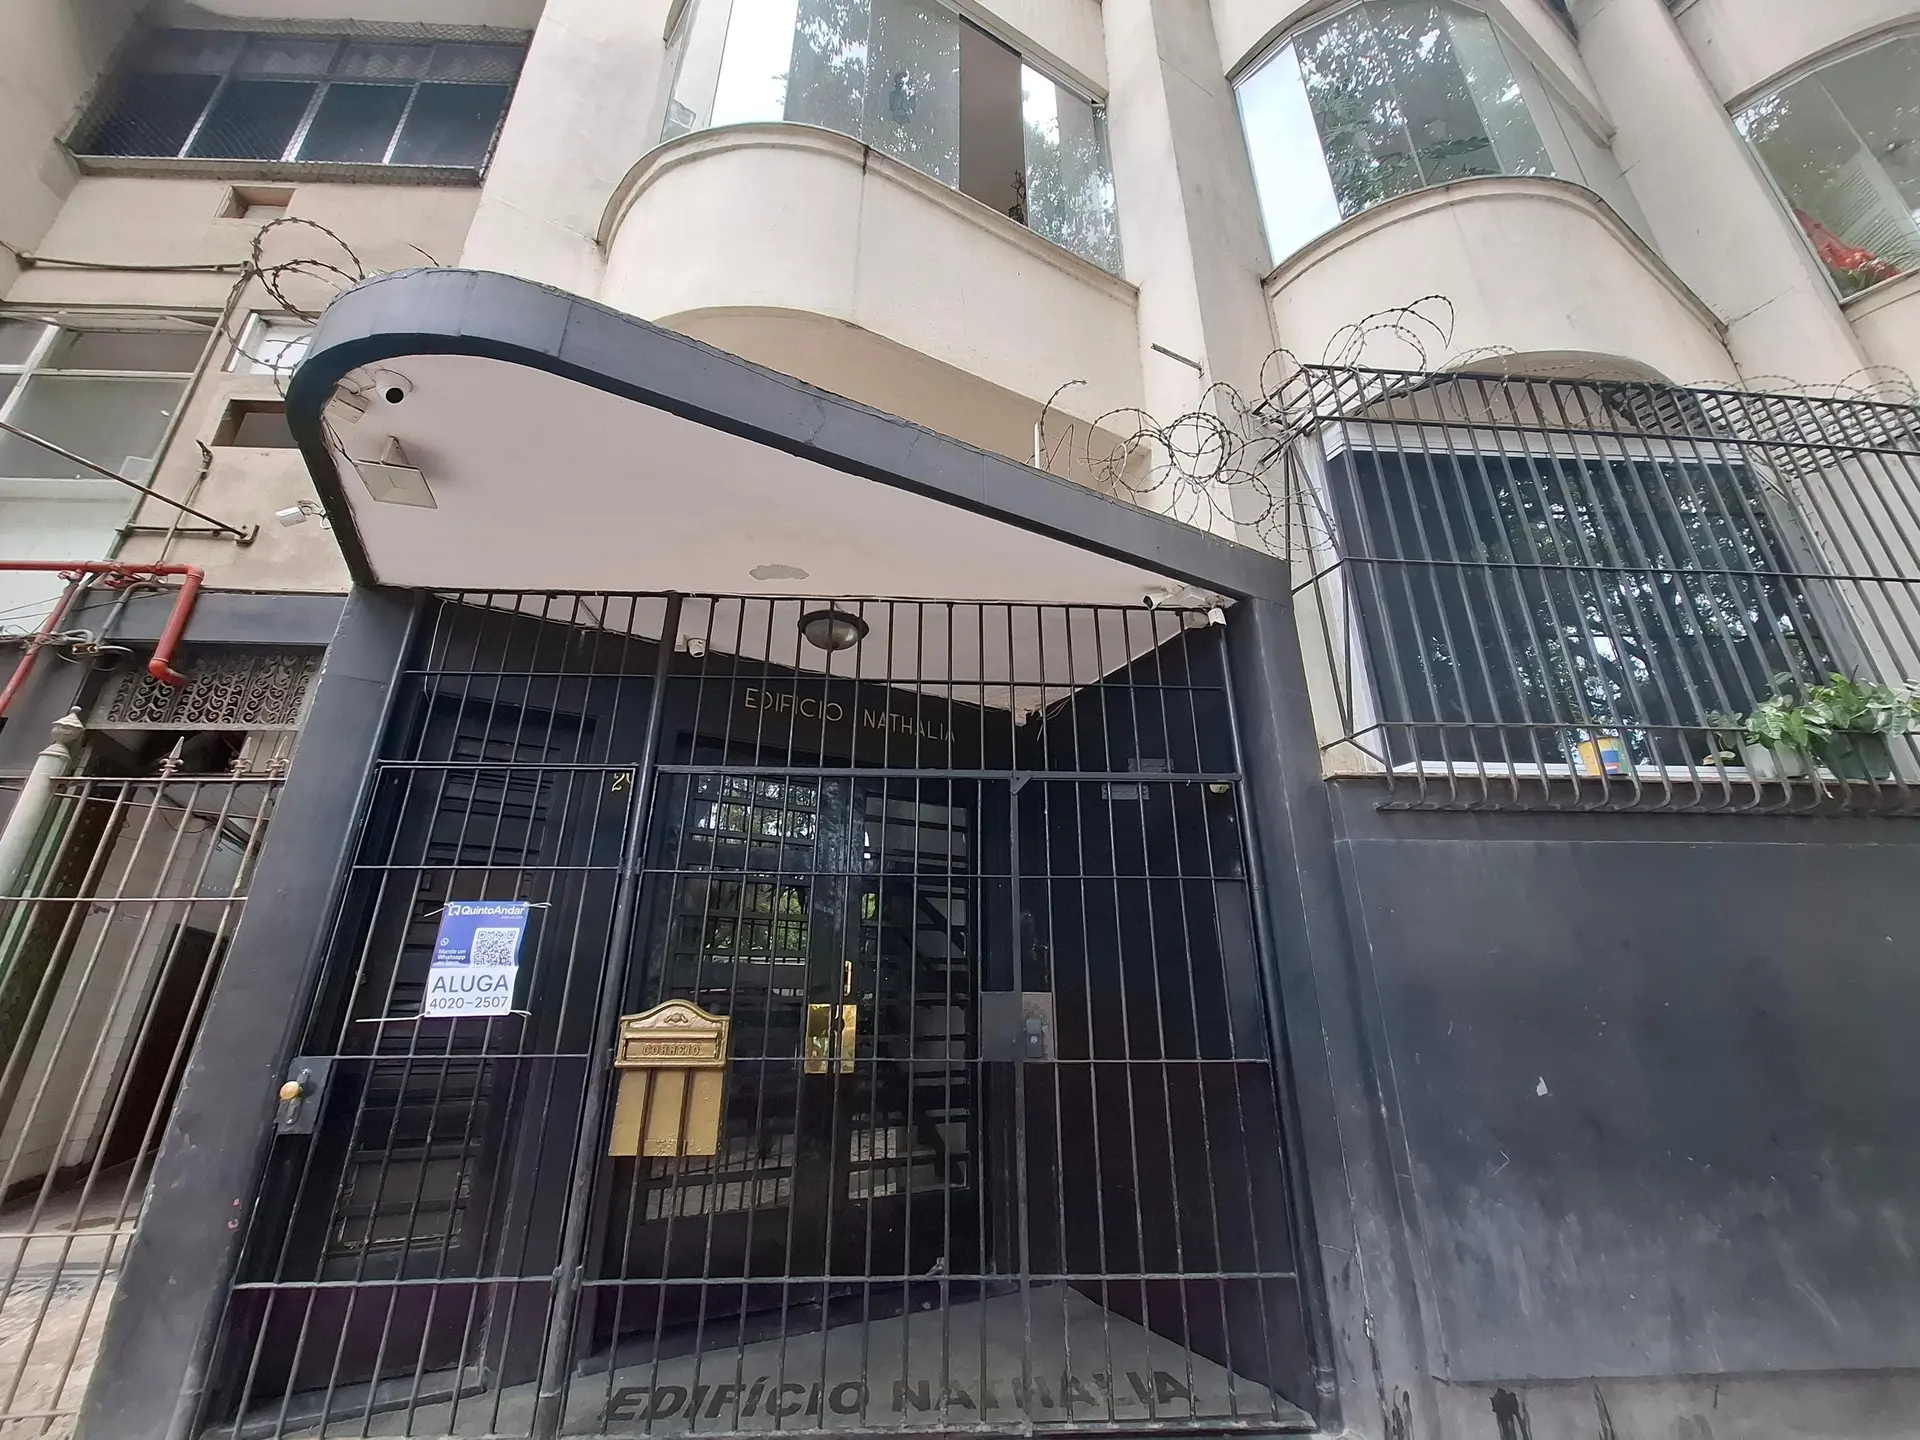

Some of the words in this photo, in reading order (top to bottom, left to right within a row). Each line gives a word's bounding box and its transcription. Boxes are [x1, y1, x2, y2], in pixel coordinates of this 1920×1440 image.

[744, 686, 844, 722] EDIFICIO
[863, 708, 956, 743] NATHALIA
[461, 905, 525, 915] QuintoAndar
[431, 974, 509, 993] ALUGA
[429, 996, 509, 1009] 4020-2507
[643, 1044, 700, 1056] CORREIO
[598, 1375, 871, 1422] EDIFÍCIO
